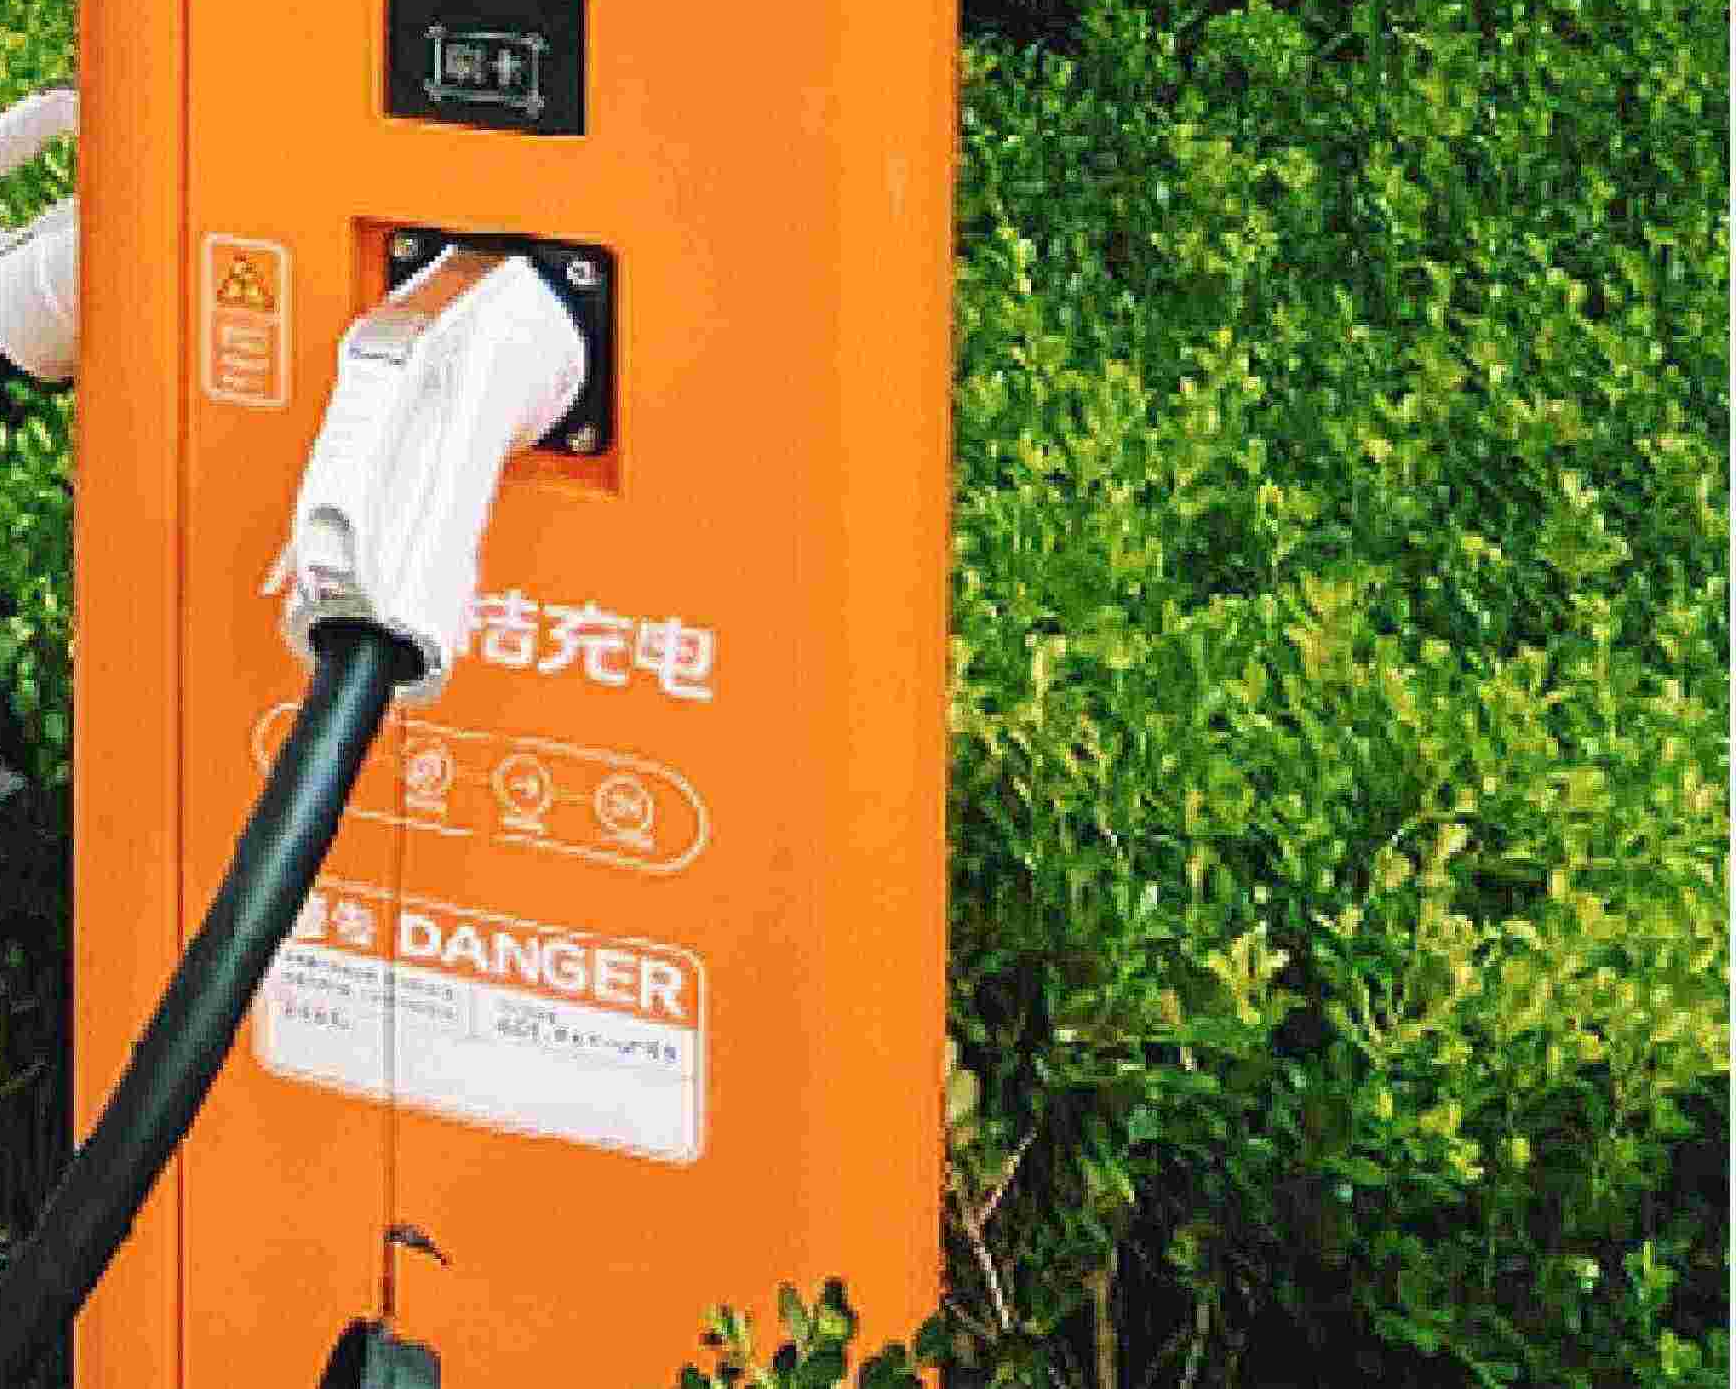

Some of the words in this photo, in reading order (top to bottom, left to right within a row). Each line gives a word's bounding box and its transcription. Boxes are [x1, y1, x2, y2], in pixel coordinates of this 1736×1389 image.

[455, 587, 714, 704] 桔充电
[398, 911, 687, 1019] DANGER
